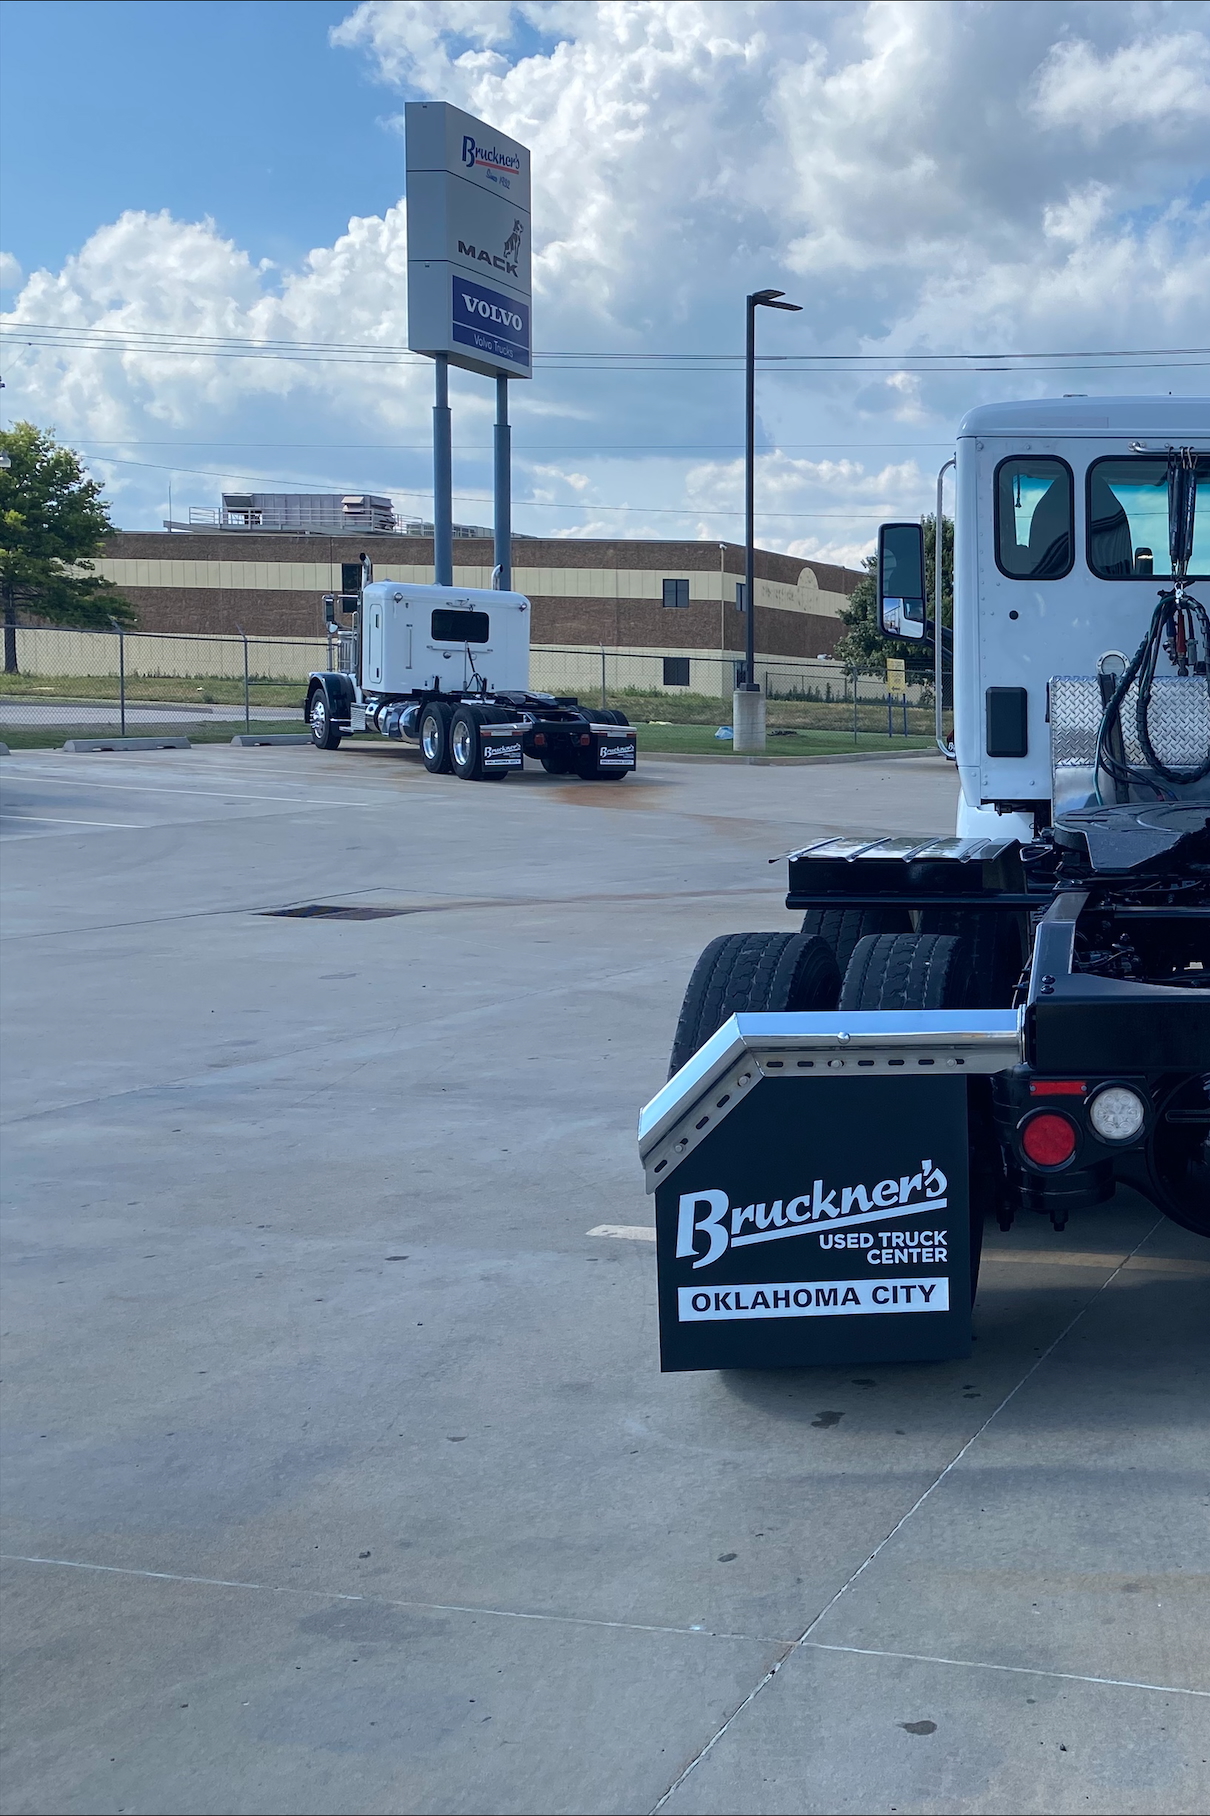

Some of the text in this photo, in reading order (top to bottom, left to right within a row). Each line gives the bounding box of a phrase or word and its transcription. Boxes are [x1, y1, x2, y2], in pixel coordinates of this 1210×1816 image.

[462, 135, 520, 169] Bruckner's
[458, 240, 518, 278] MACK
[462, 293, 523, 331] VOLVO
[474, 334, 514, 358] Volvo Trucks
[675, 1159, 948, 1269] Bruckner's
[820, 1231, 948, 1249] USED TRUCK
[867, 1248, 948, 1265] CENTER
[691, 1284, 937, 1312] OKLAHOMA CITY
